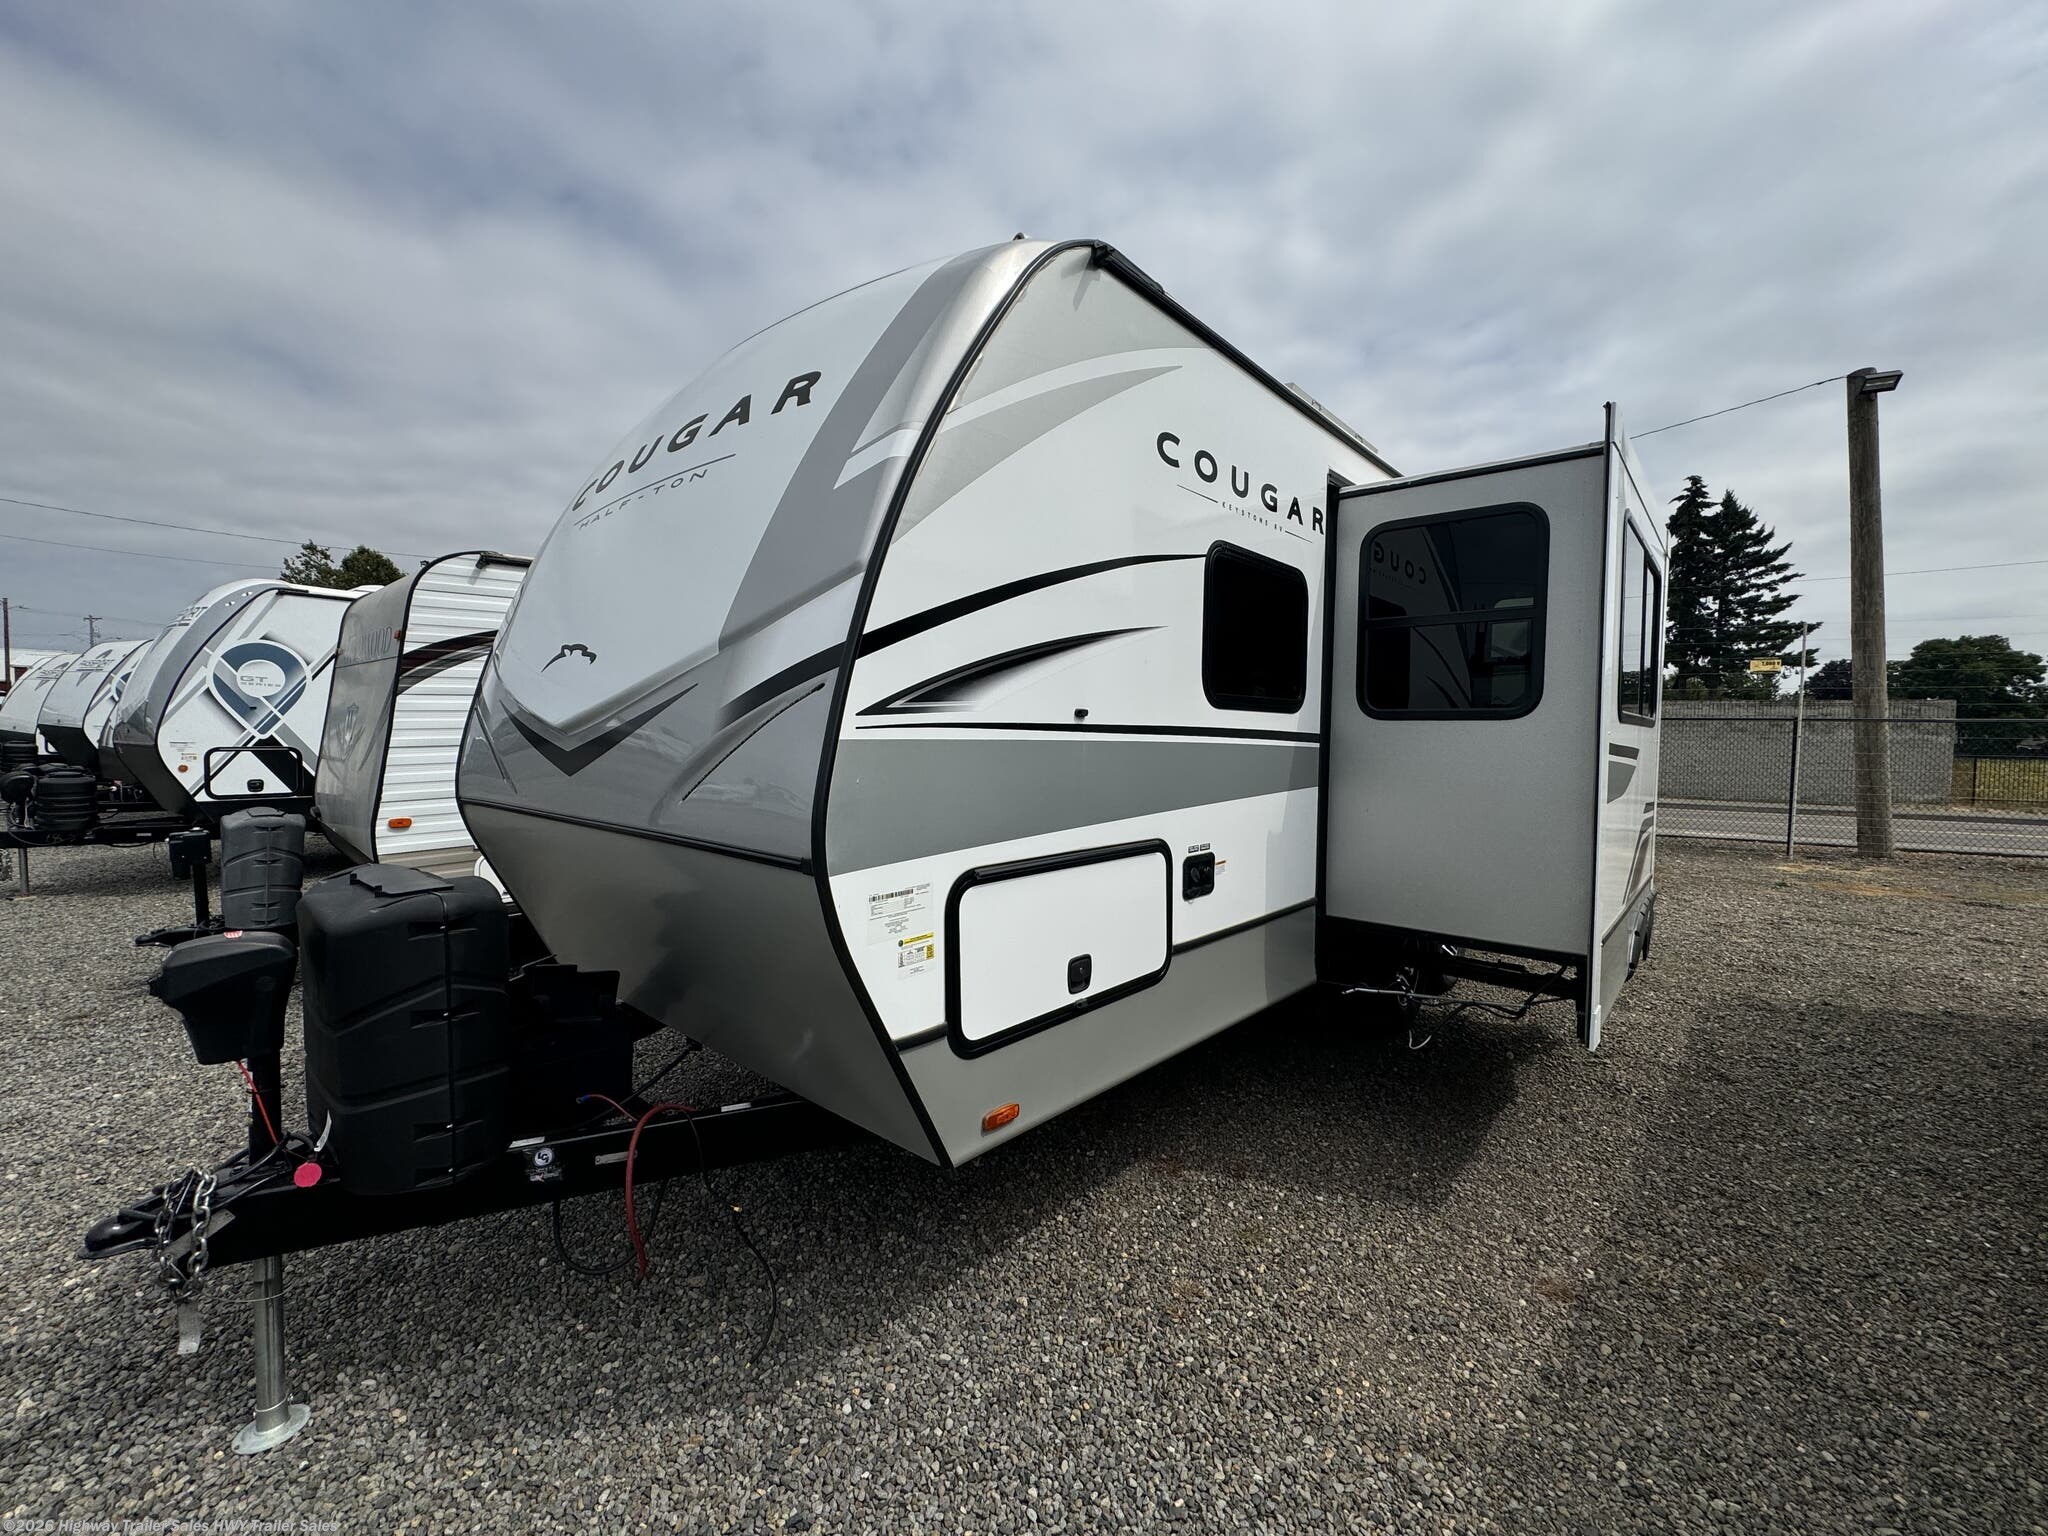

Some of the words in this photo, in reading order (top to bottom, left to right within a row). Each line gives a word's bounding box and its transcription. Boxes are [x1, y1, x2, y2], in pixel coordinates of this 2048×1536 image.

[572, 371, 822, 511] COUGAR
[1156, 431, 1324, 535] COUGAR
[579, 469, 707, 530] HALF-TON
